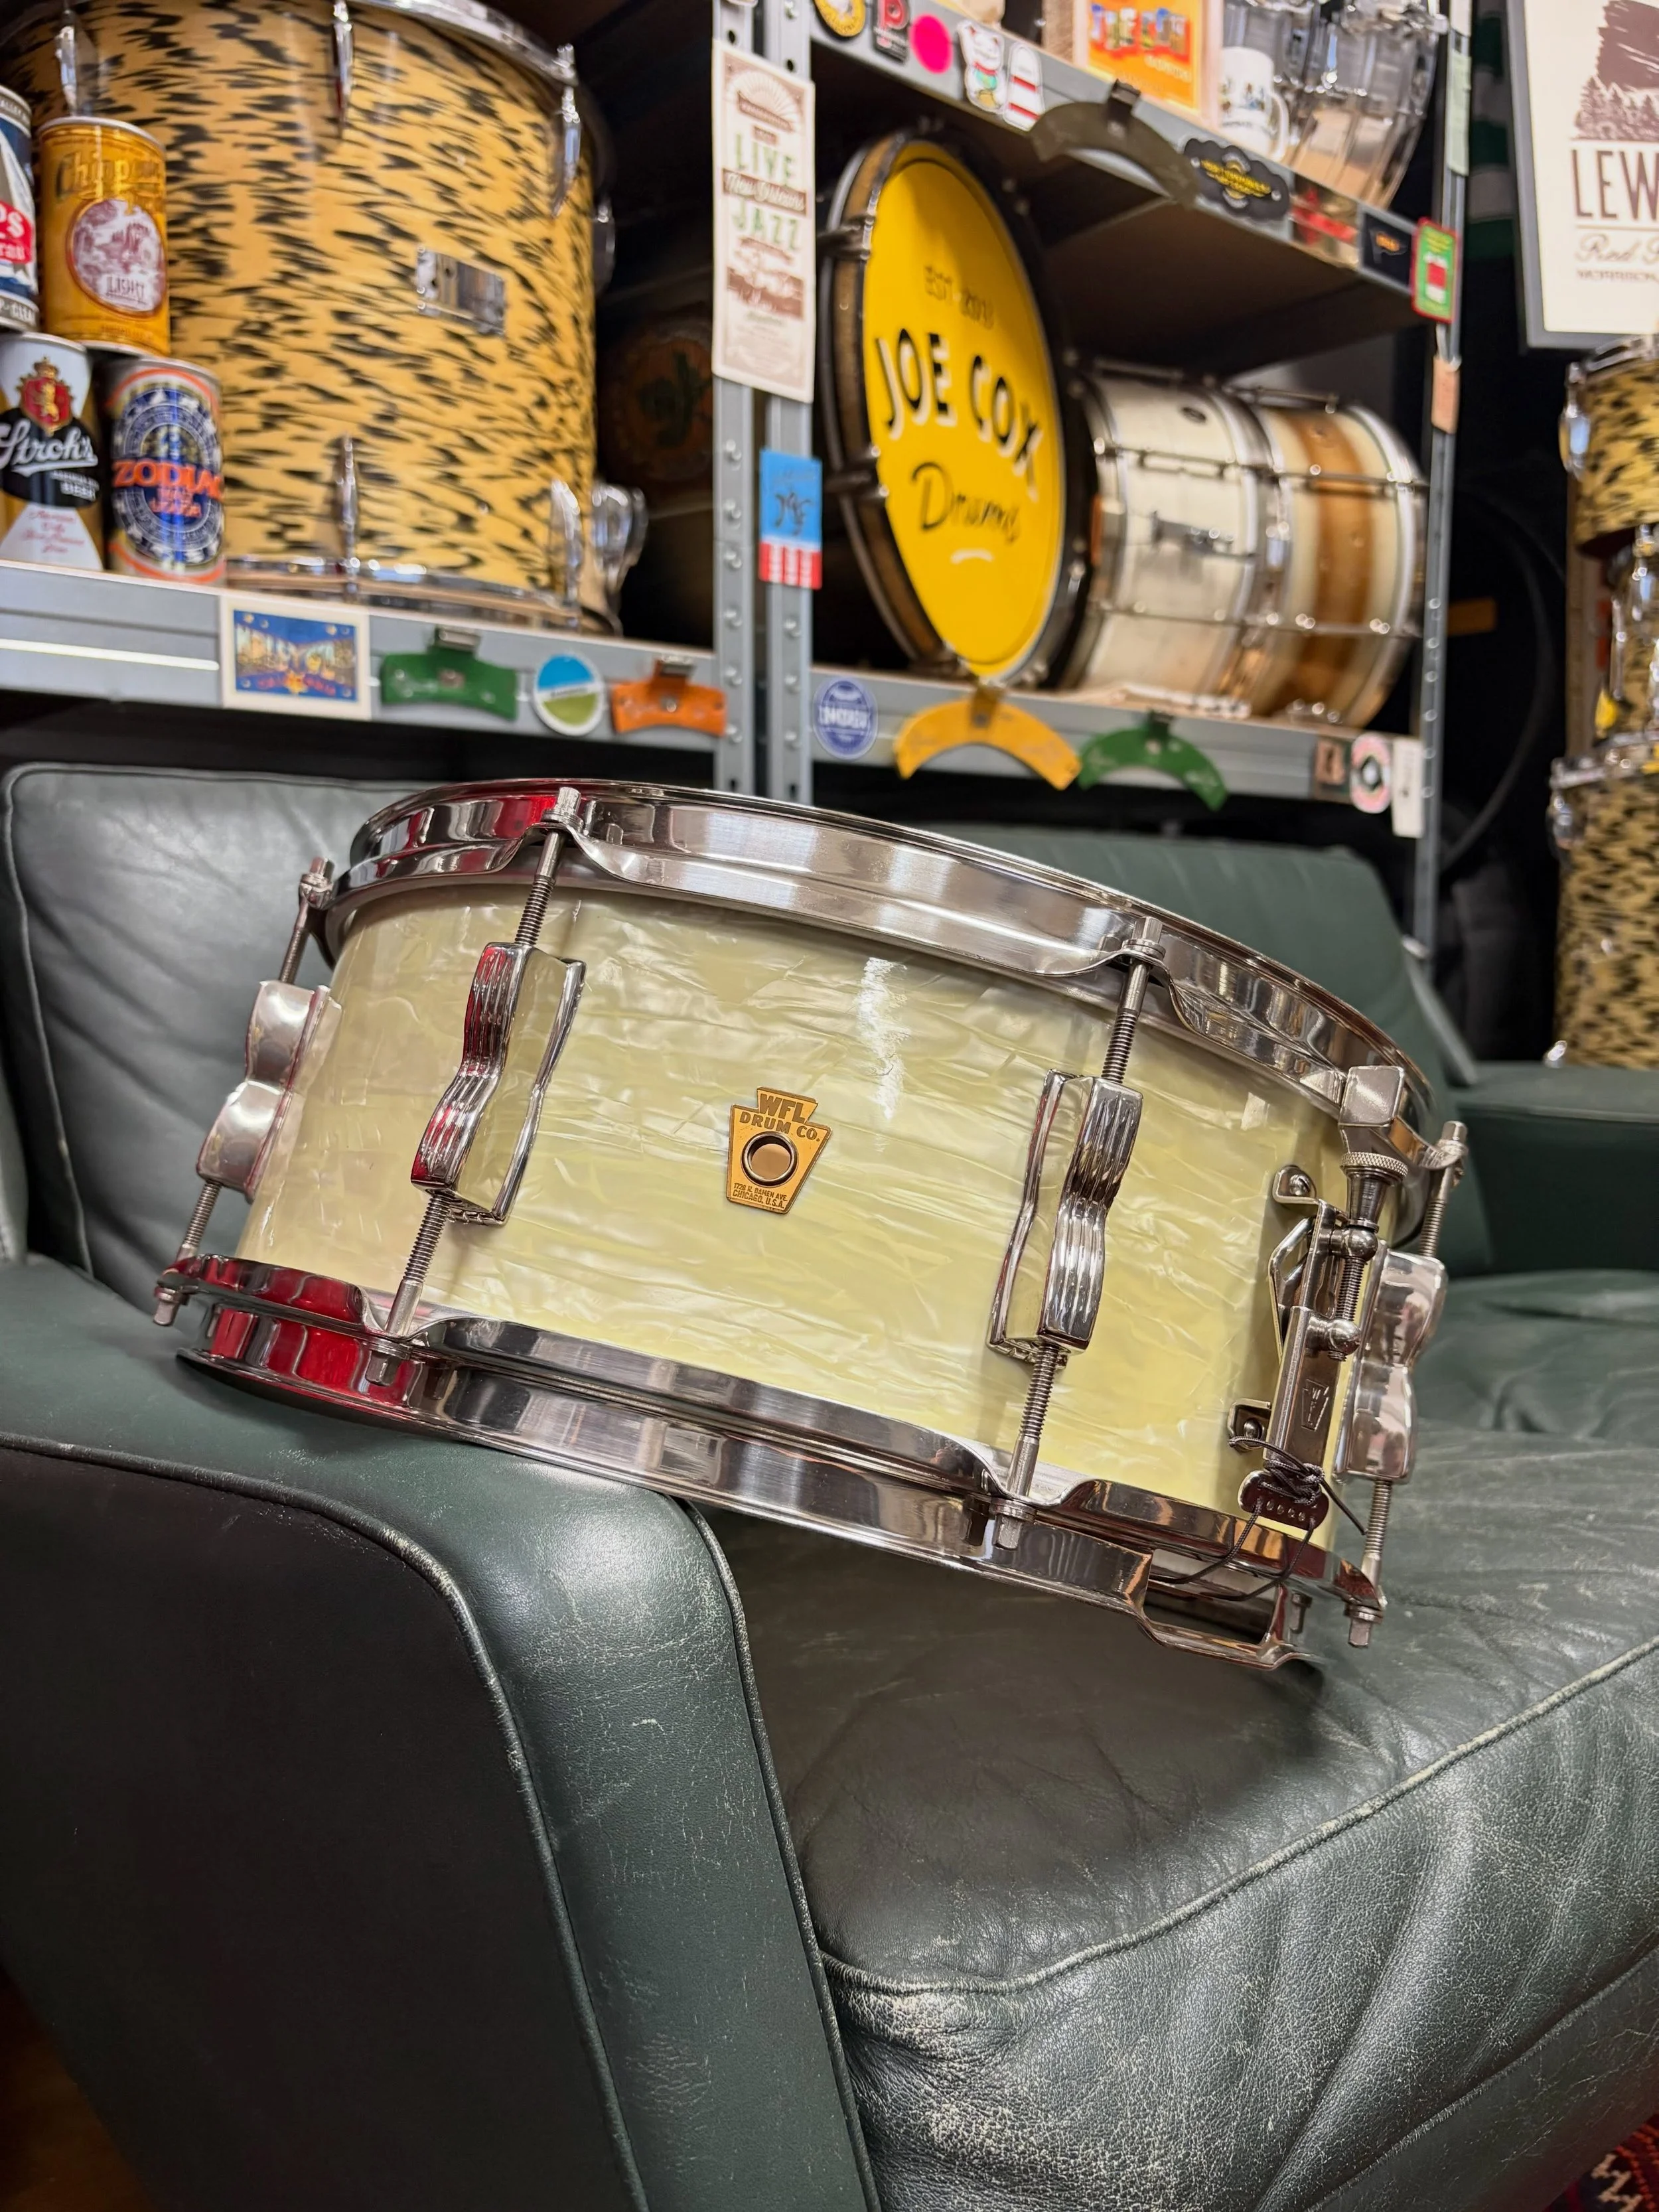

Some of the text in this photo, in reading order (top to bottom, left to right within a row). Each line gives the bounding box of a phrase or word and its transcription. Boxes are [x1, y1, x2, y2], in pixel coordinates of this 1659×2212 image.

[736, 133, 794, 187] LIVE
[731, 200, 800, 251] JAZZ
[875, 328, 1043, 502] JOE COX
[910, 460, 1021, 547] Drums
[739, 1111, 820, 1142] DRUM CO.
[758, 1093, 806, 1125] WFL
[733, 1183, 747, 1191] 1728
[755, 1187, 775, 1199] DAMEN
